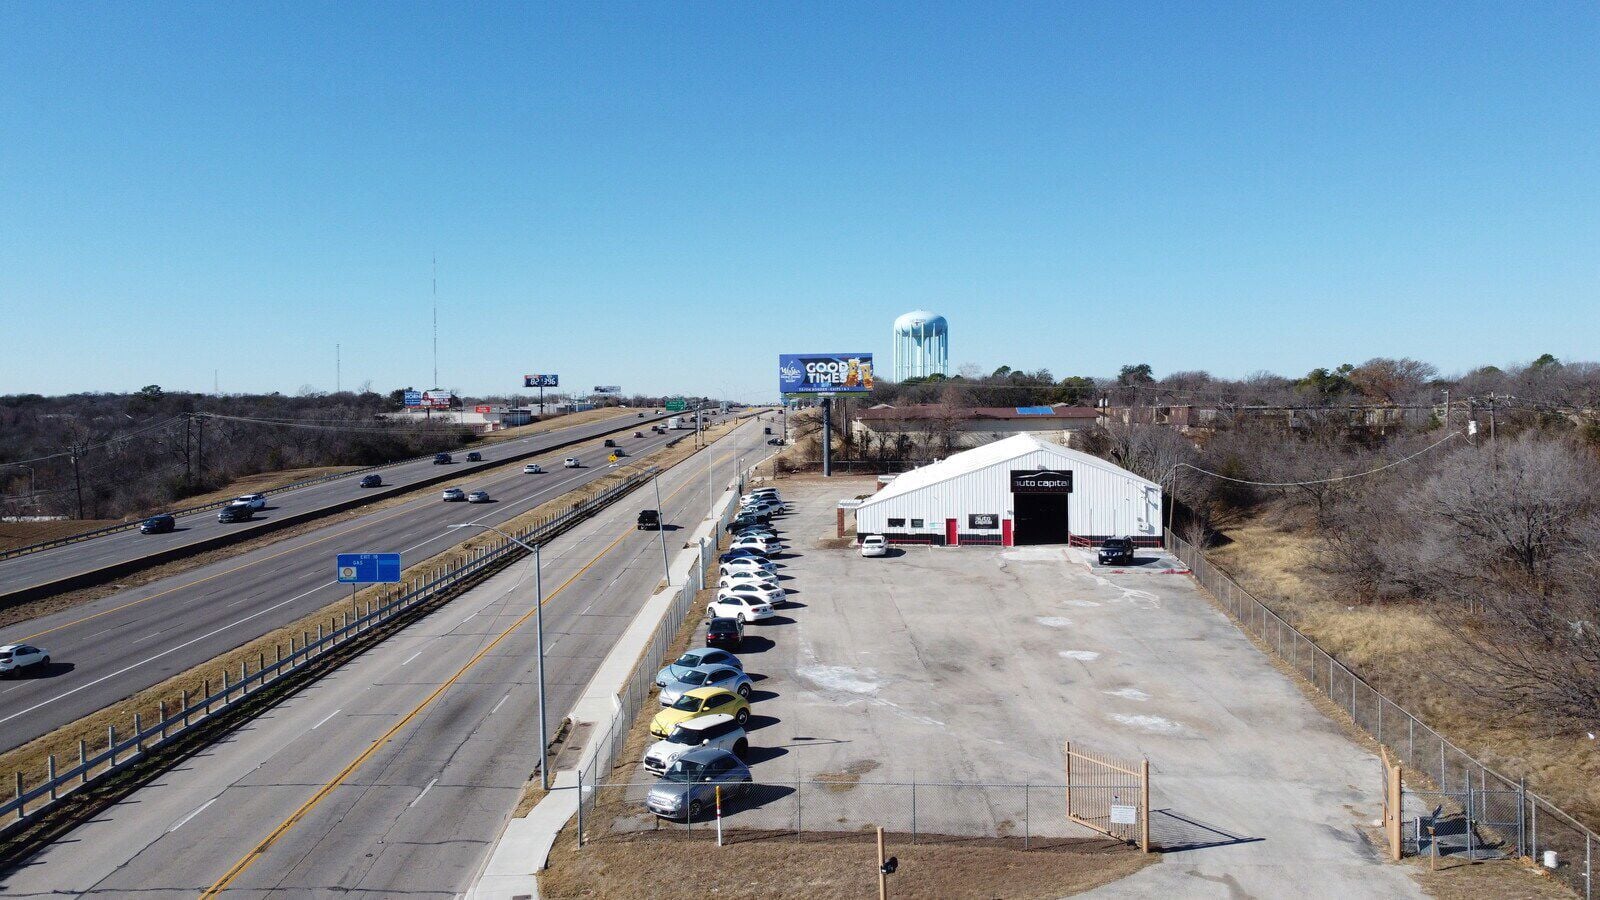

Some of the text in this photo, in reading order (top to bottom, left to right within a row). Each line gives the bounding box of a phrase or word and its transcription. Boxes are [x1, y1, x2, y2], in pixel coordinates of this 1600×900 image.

[806, 362, 848, 372] GOOD
[544, 377, 556, 385] 396
[807, 373, 847, 383] TIMES
